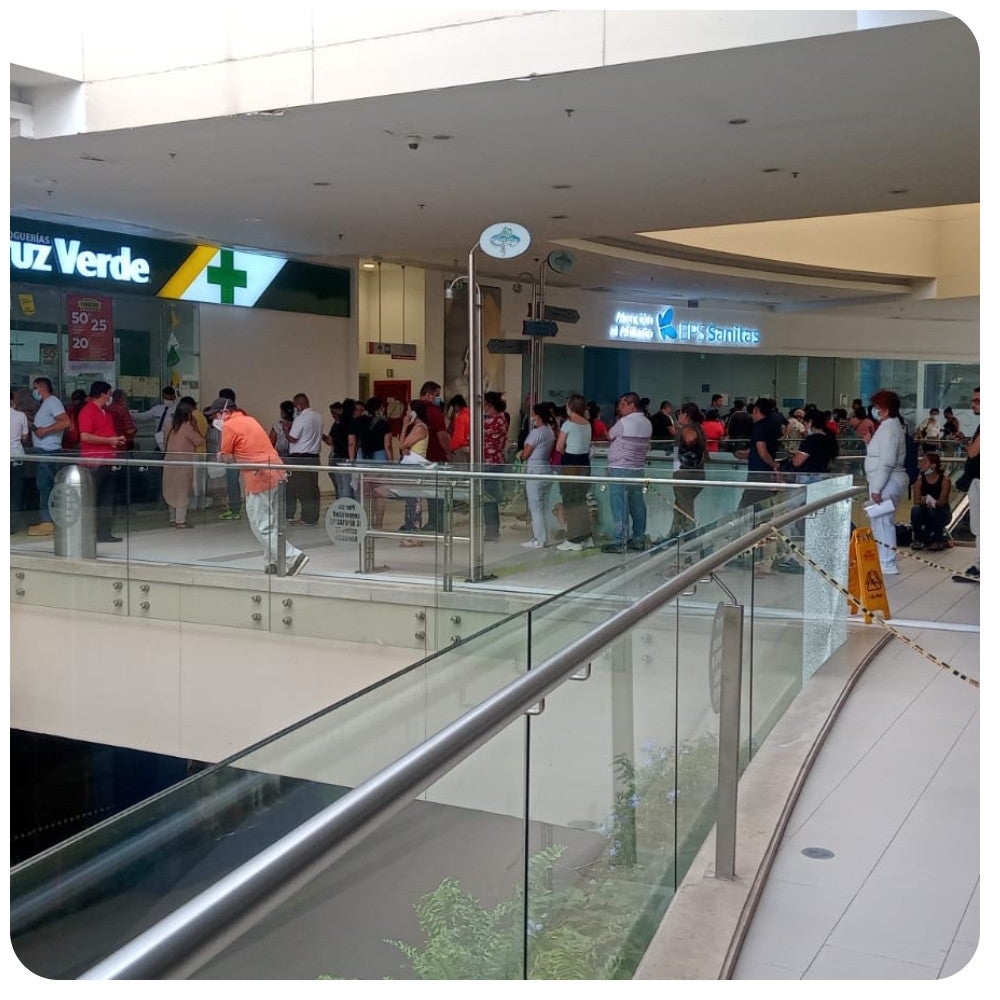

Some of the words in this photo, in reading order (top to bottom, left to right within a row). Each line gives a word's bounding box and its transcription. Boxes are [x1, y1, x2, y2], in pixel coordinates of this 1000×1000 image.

[53, 237, 150, 284] Verde
[71, 311, 89, 324] 50
[90, 319, 107, 332] 25
[705, 324, 761, 344] Sanitas
[72, 337, 89, 349] 20
